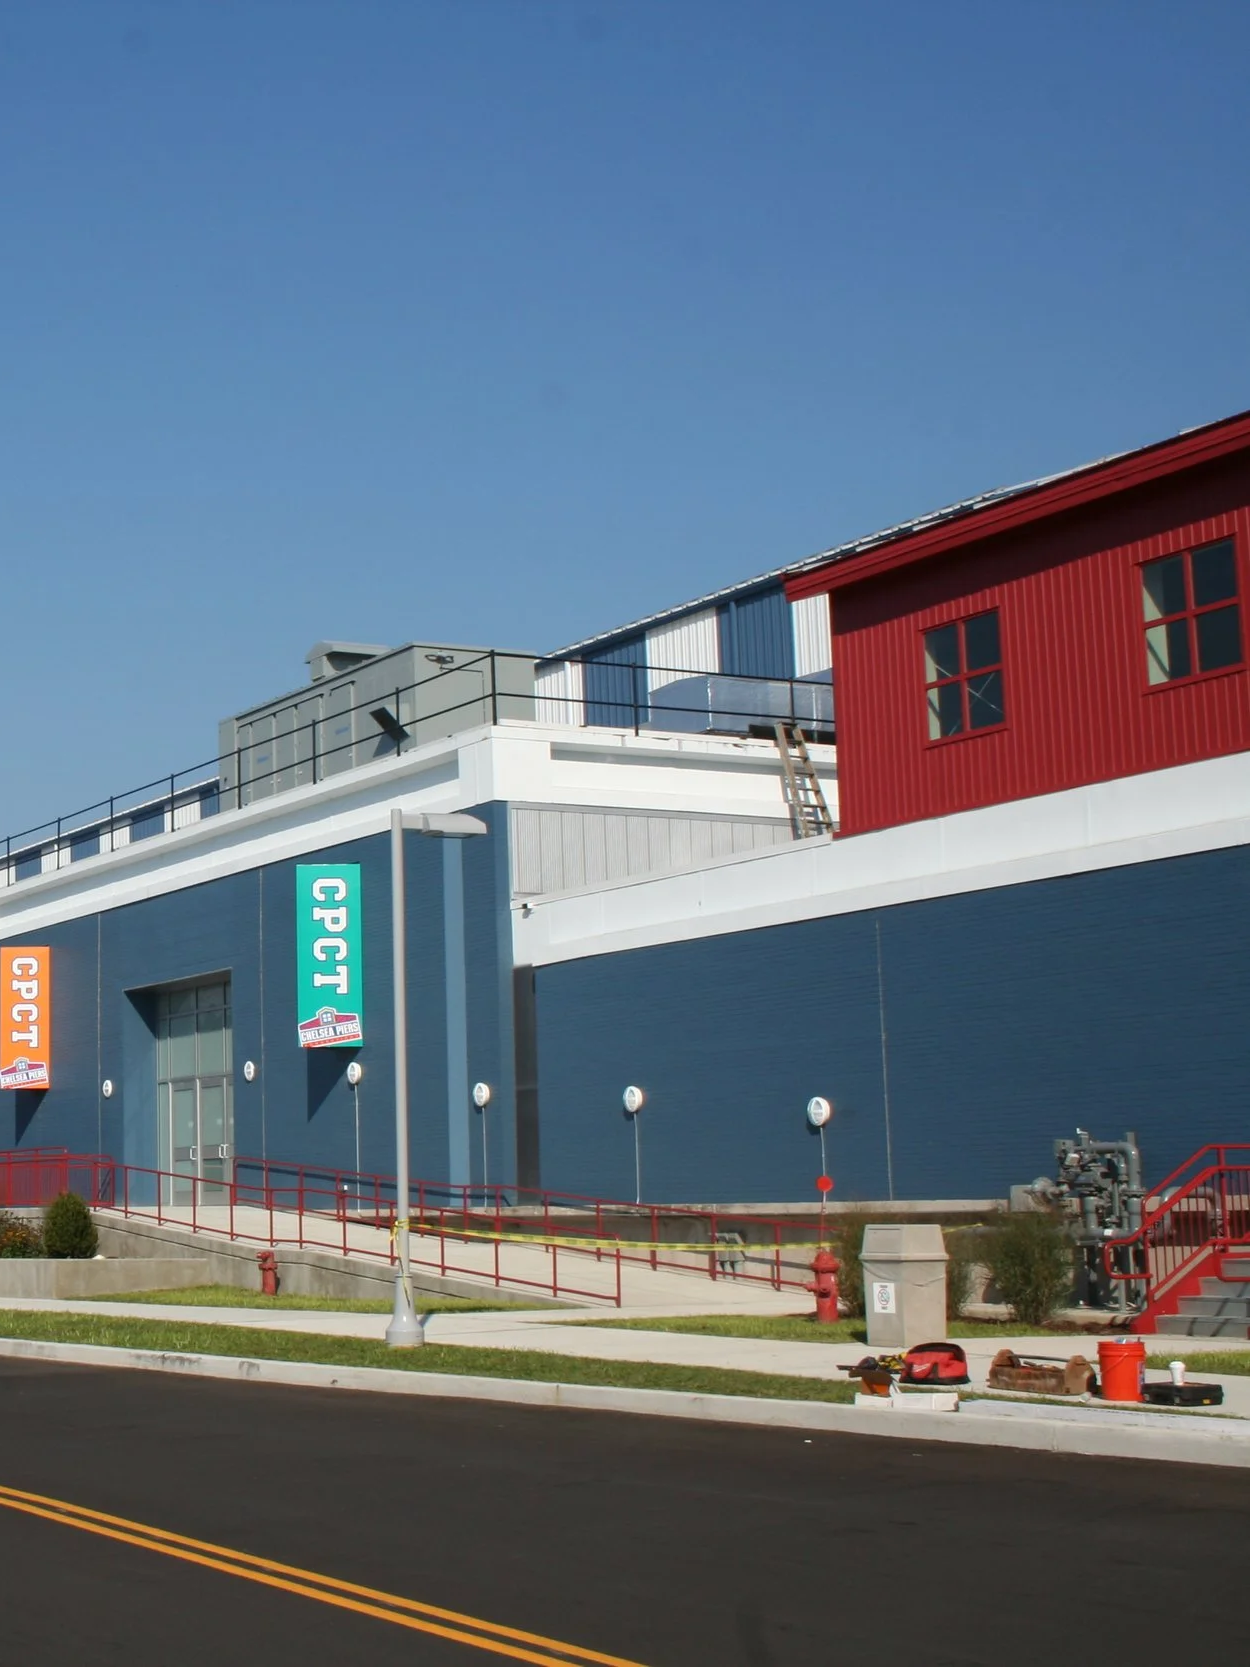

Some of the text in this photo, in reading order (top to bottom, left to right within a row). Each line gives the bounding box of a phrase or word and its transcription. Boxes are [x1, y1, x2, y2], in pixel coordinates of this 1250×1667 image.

[311, 877, 349, 995] CPCT
[11, 956, 40, 1048] CPCT
[301, 1026, 335, 1042] CHELSEA
[335, 1022, 359, 1036] PIERS
